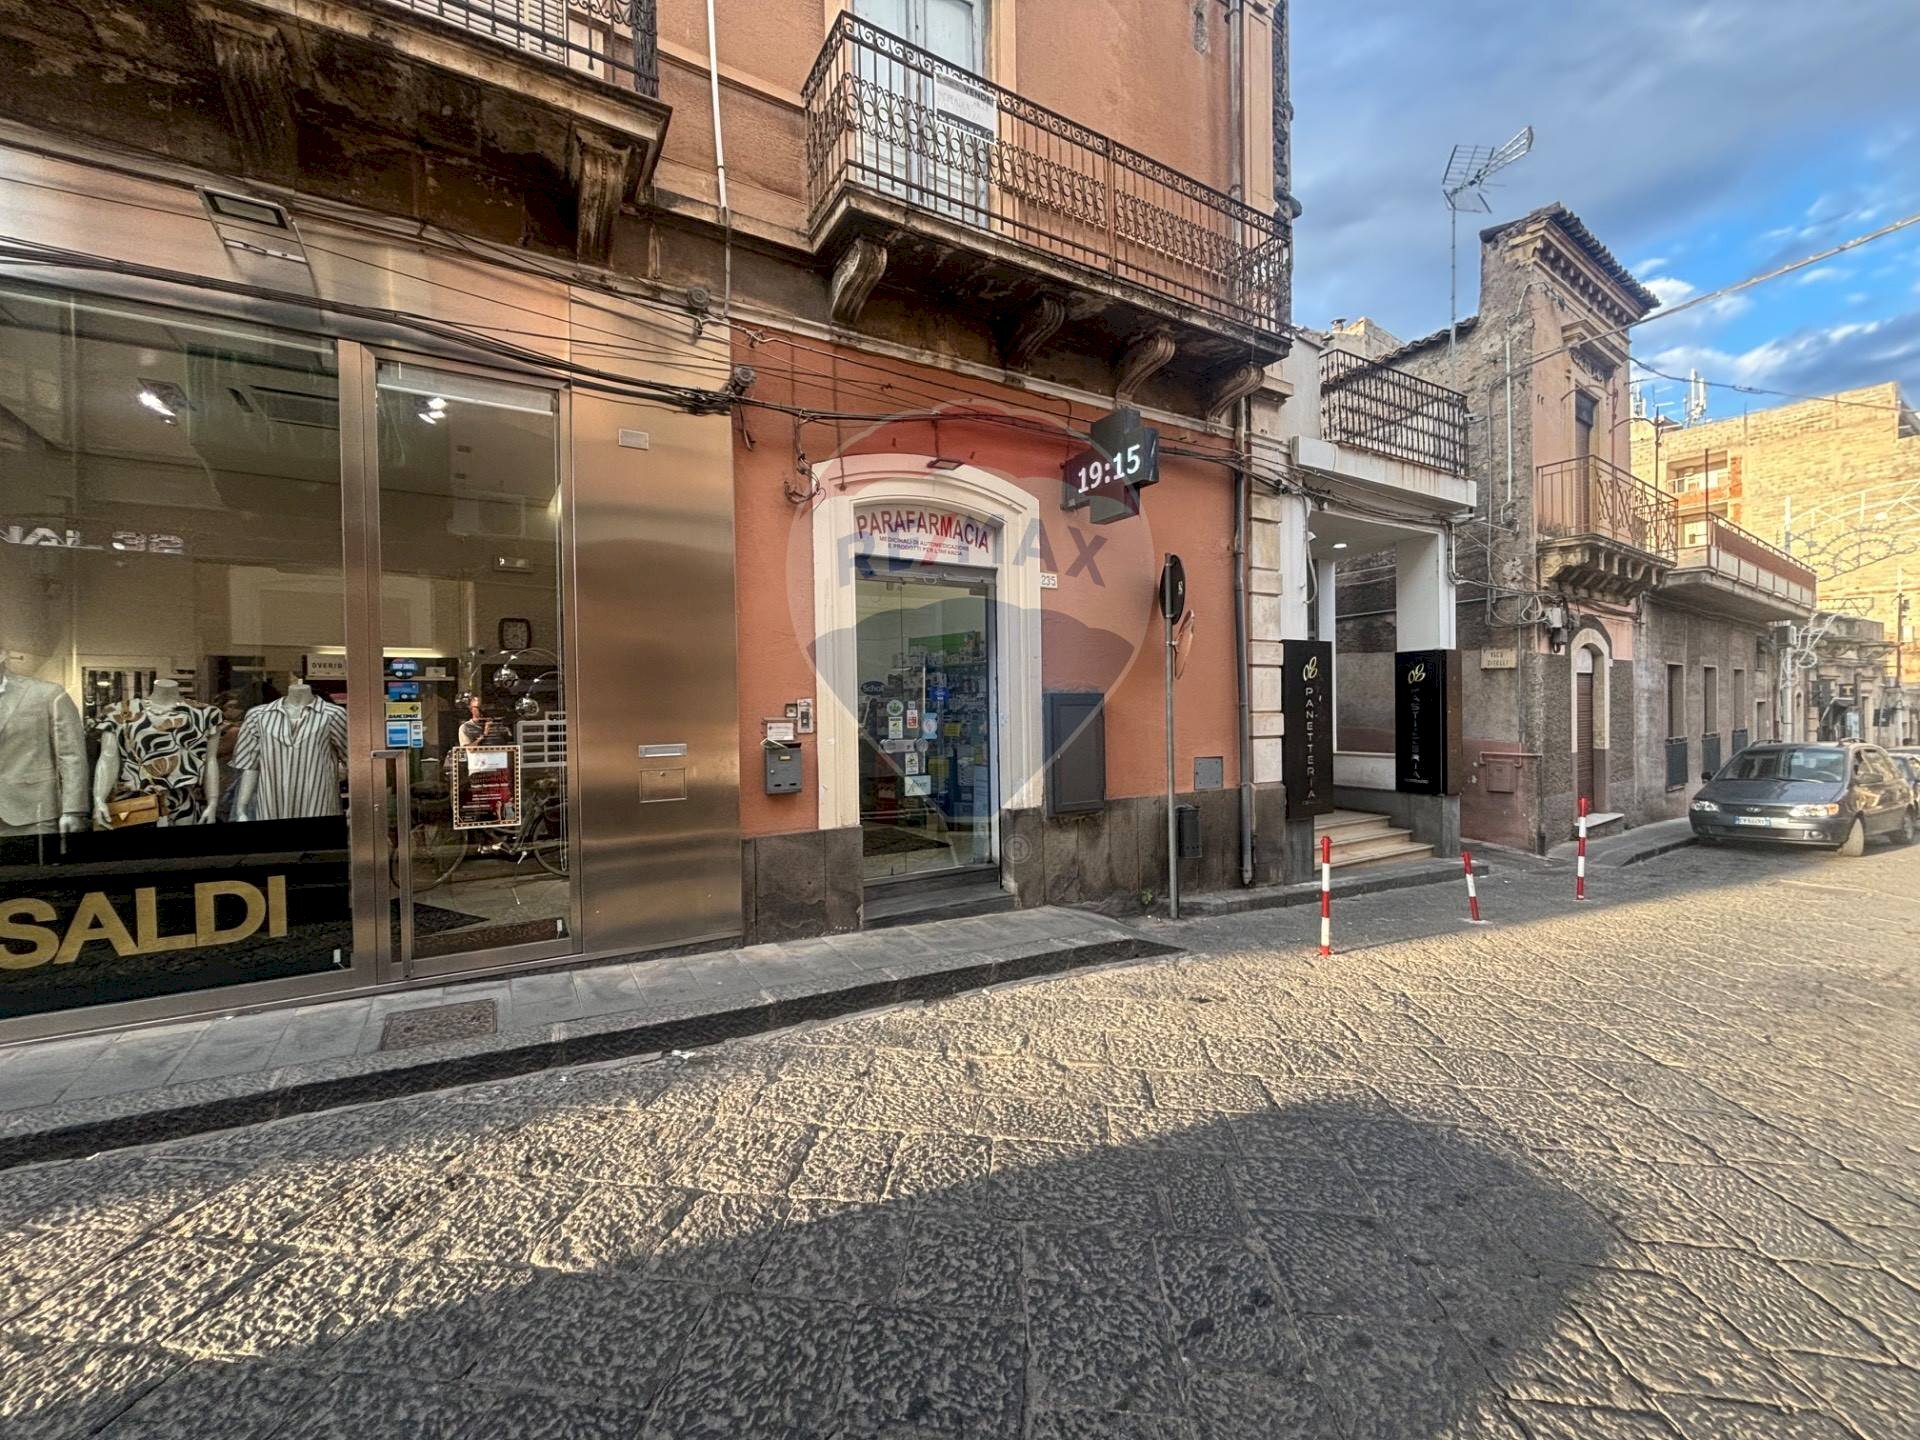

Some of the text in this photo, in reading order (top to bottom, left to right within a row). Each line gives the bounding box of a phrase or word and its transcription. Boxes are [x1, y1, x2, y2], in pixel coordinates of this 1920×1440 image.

[1078, 444, 1140, 493] 19:15
[856, 510, 989, 553] PARAFARMACIA
[879, 536, 913, 545] MEDICINALI
[920, 540, 969, 551] AUTOMEDICAZIONE
[893, 543, 922, 551] PRODOTTI
[1041, 575, 1056, 586] 235
[1305, 687, 1316, 799] PANETTERIA
[1410, 688, 1420, 779] PASTIERIA
[0, 875, 288, 970] SALDI
